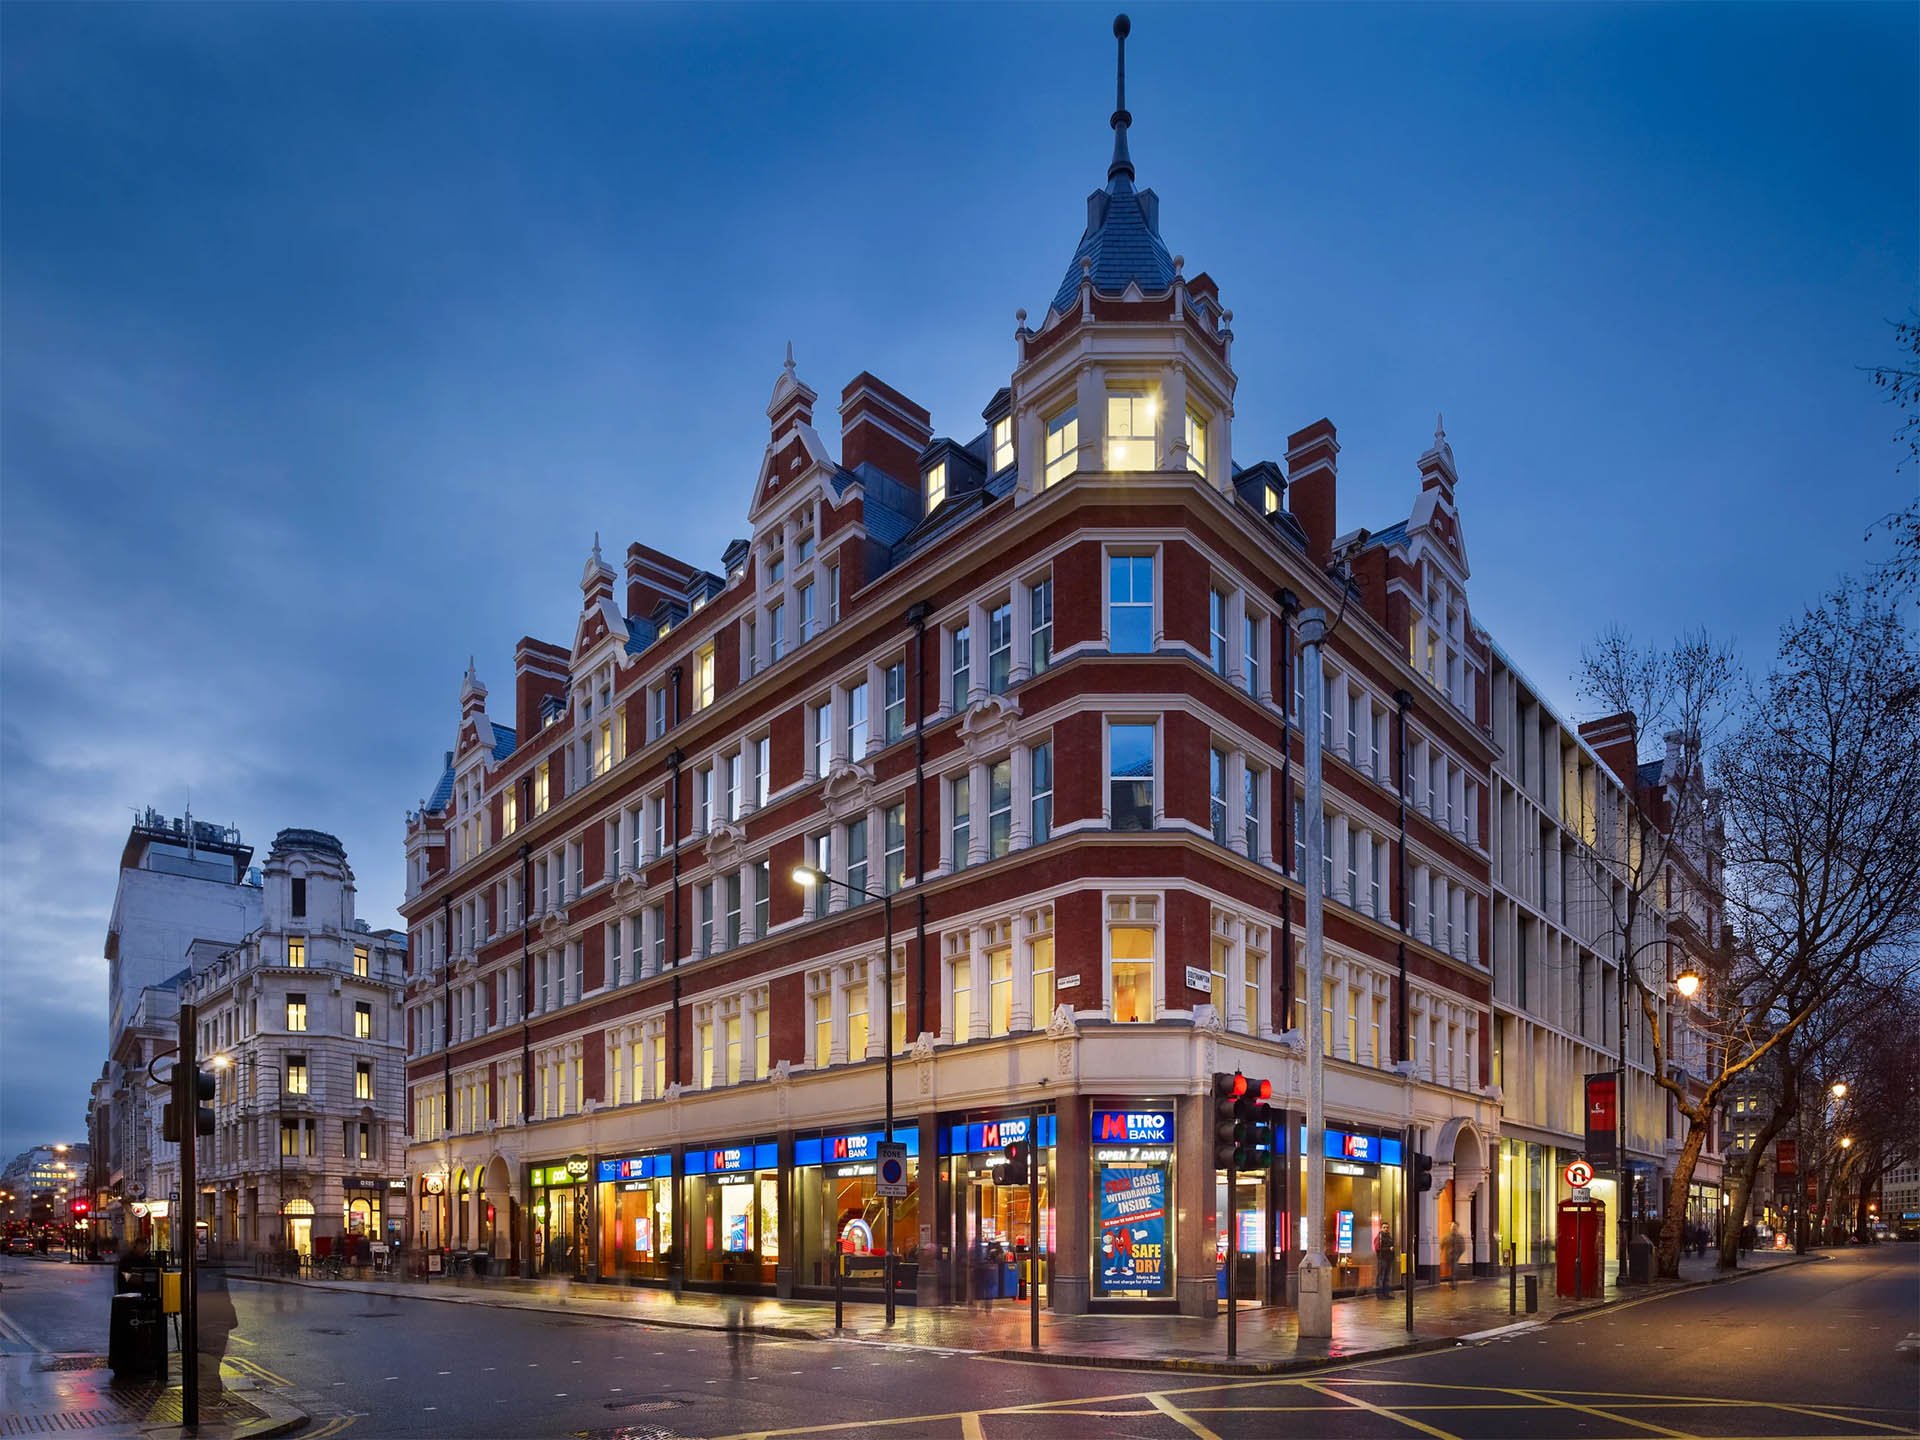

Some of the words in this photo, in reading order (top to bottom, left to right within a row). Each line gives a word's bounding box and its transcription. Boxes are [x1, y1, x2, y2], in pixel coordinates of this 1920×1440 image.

[1188, 970, 1210, 984] SOUTHAMPTON
[1101, 1114, 1165, 1139] METRO
[982, 1121, 1026, 1148] METRO
[1129, 1130, 1165, 1140] BANK
[833, 1135, 868, 1158] METRO
[848, 1148, 868, 1158] BANK
[1098, 1150, 1127, 1160] OPEN
[1130, 1148, 1140, 1160] 7
[1141, 1150, 1168, 1160] DAYS
[567, 1160, 588, 1172] pod
[725, 1161, 741, 1169] BANK
[853, 1165, 859, 1175] 7
[730, 1174, 735, 1184] 7
[1105, 1178, 1131, 1193] FREE
[1133, 1172, 1160, 1188] CASH
[1106, 1185, 1161, 1203] WITHDRAWALS
[1118, 1197, 1152, 1214] INSIDE
[1131, 1244, 1161, 1258] SAFE
[1128, 1259, 1135, 1268] &
[1135, 1259, 1160, 1273] DRY
